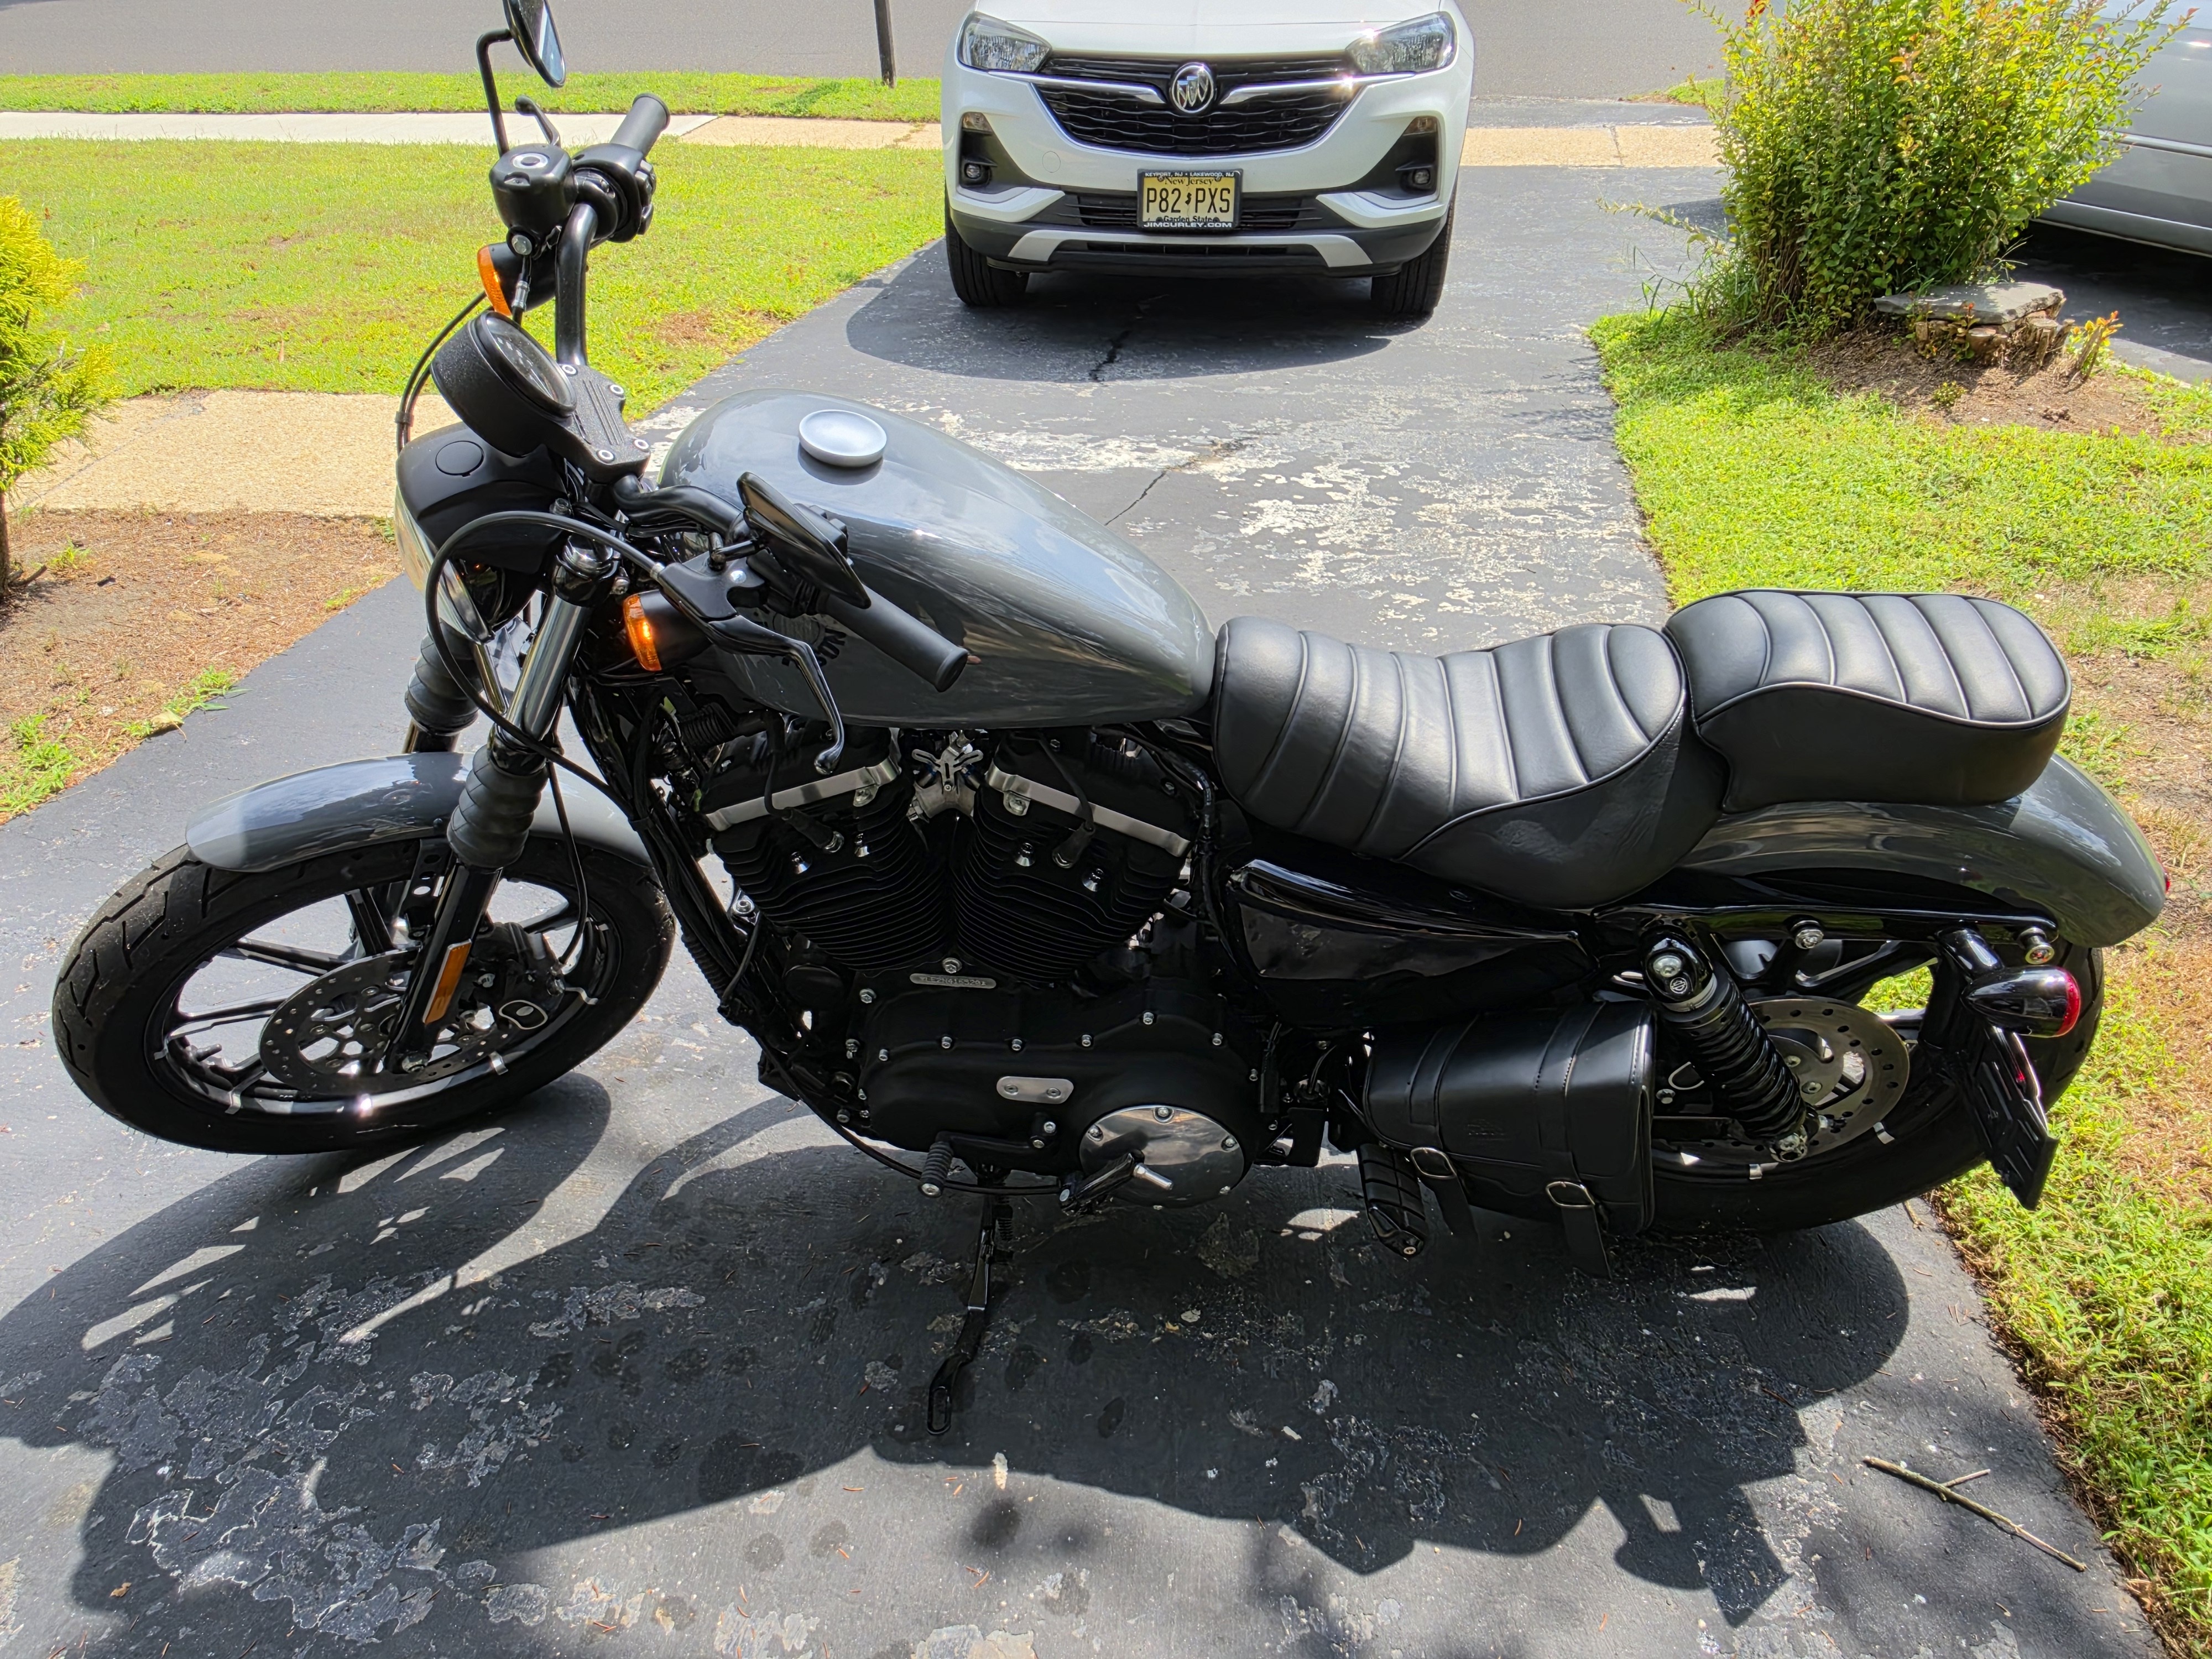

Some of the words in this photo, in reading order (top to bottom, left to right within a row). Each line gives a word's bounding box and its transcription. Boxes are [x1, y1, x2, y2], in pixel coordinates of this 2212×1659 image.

[1165, 177, 1186, 185] New
[1186, 178, 1214, 186] Jersey
[1146, 187, 1182, 213] P82
[1194, 187, 1231, 213] PXS
